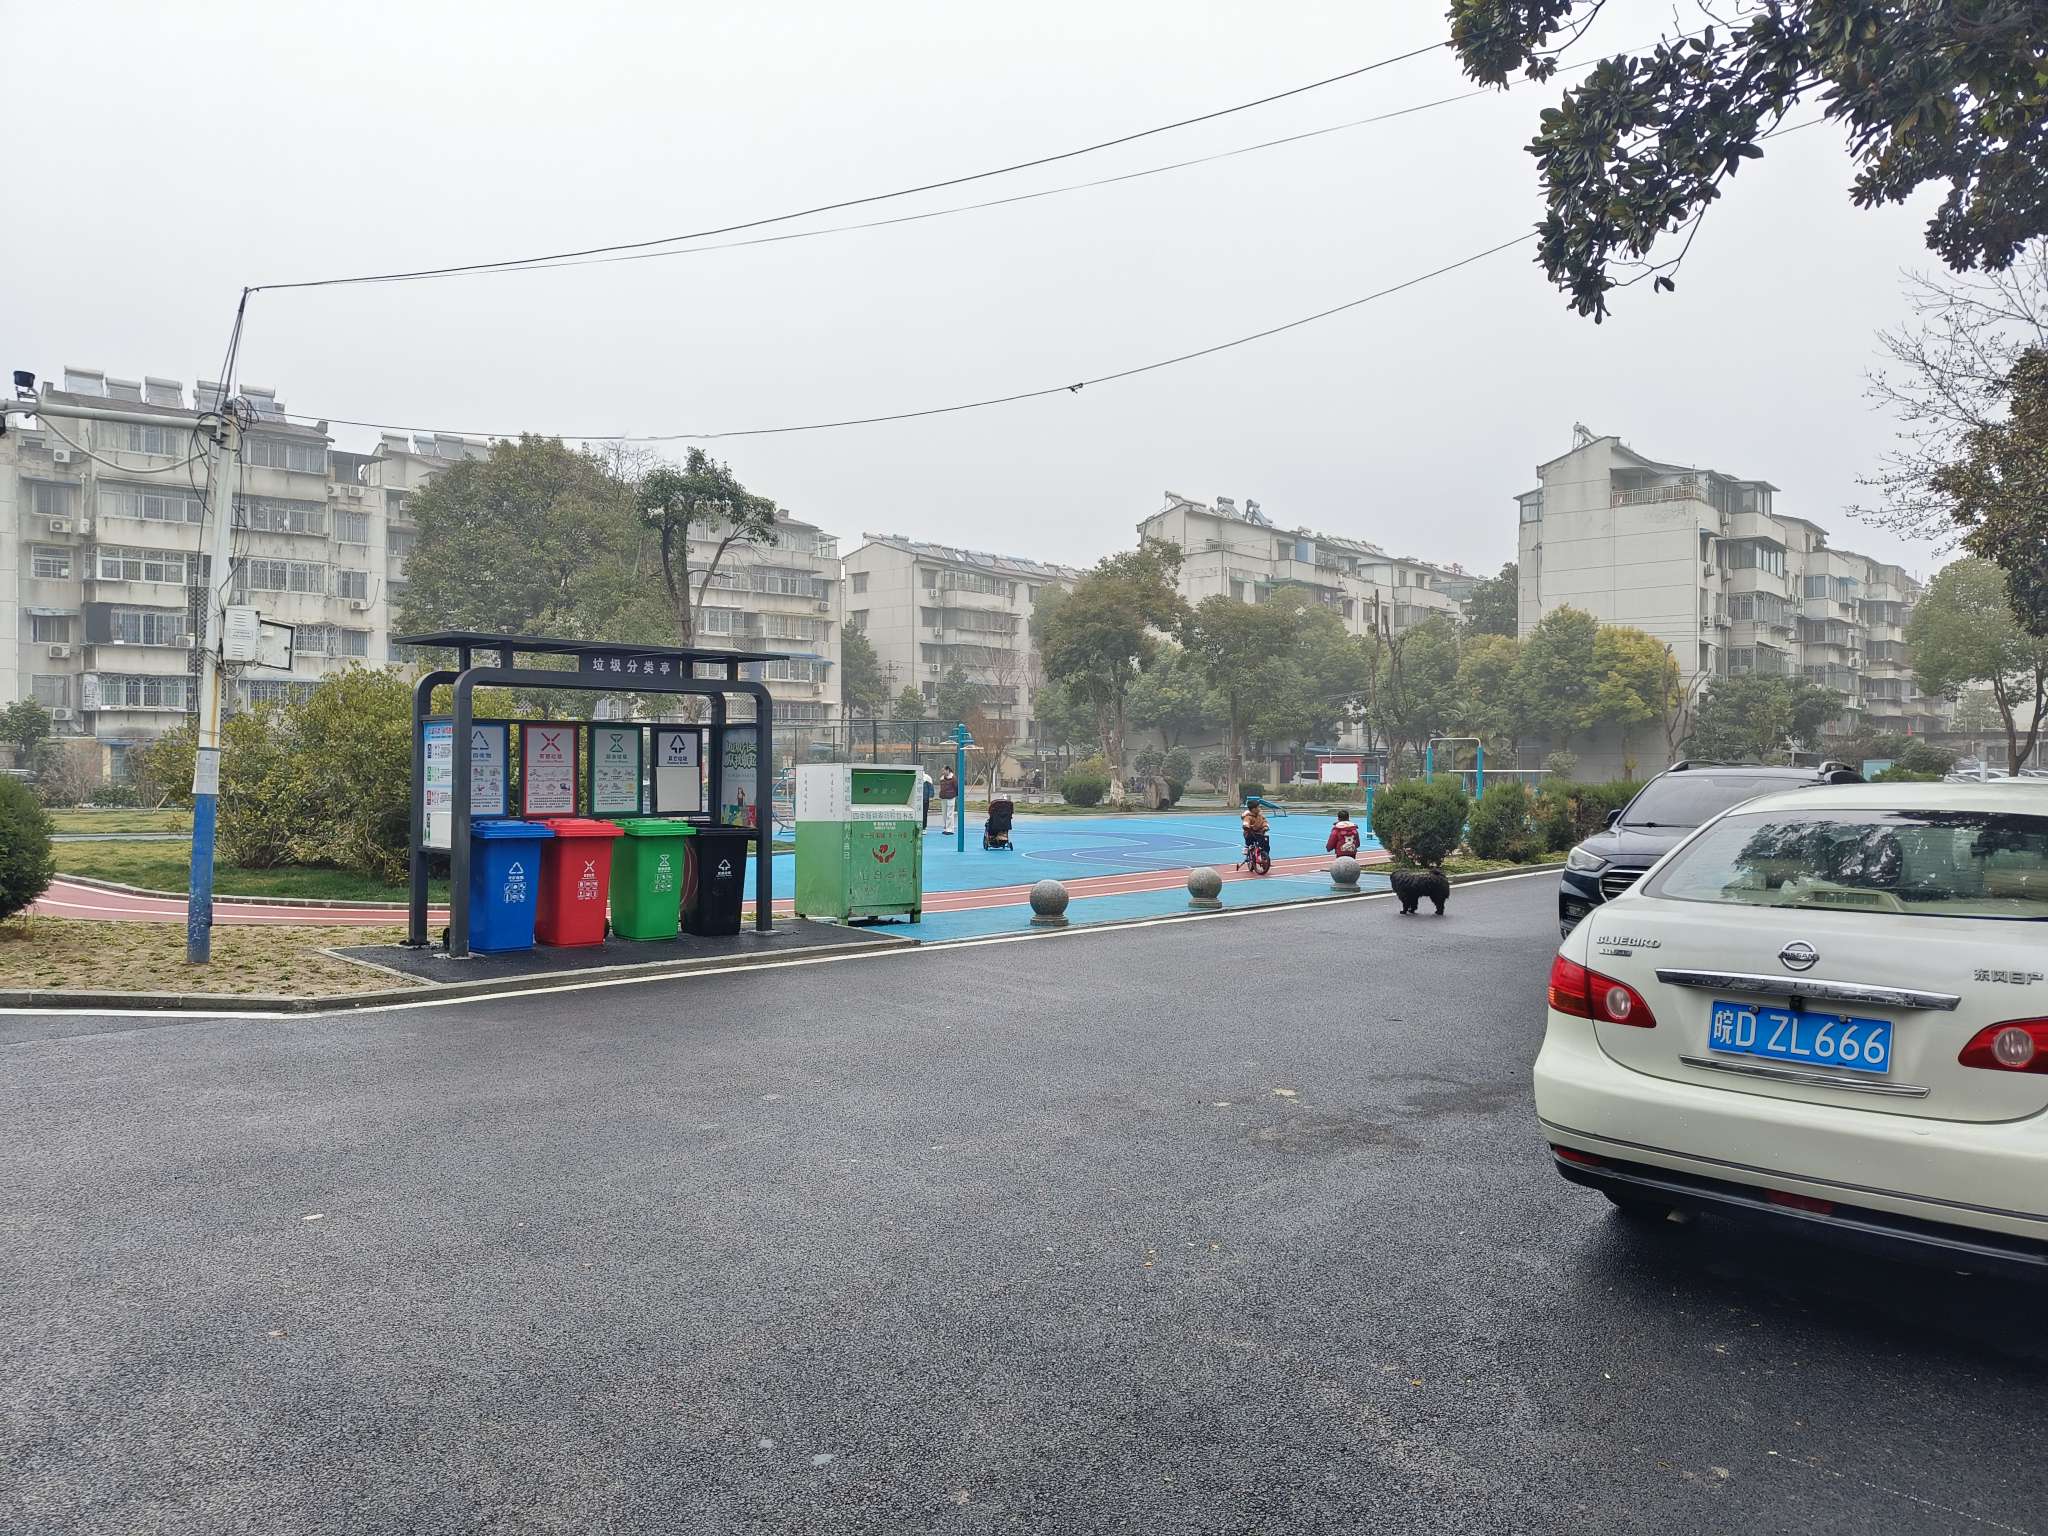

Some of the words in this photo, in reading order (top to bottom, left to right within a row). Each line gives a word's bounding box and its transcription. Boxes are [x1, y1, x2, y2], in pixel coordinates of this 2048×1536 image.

[592, 656, 671, 676] 垃圾分类亭
[1596, 936, 1662, 949] BLUEBIRD
[1781, 951, 1815, 961] NISSAN
[1973, 968, 2044, 985] 东风日产
